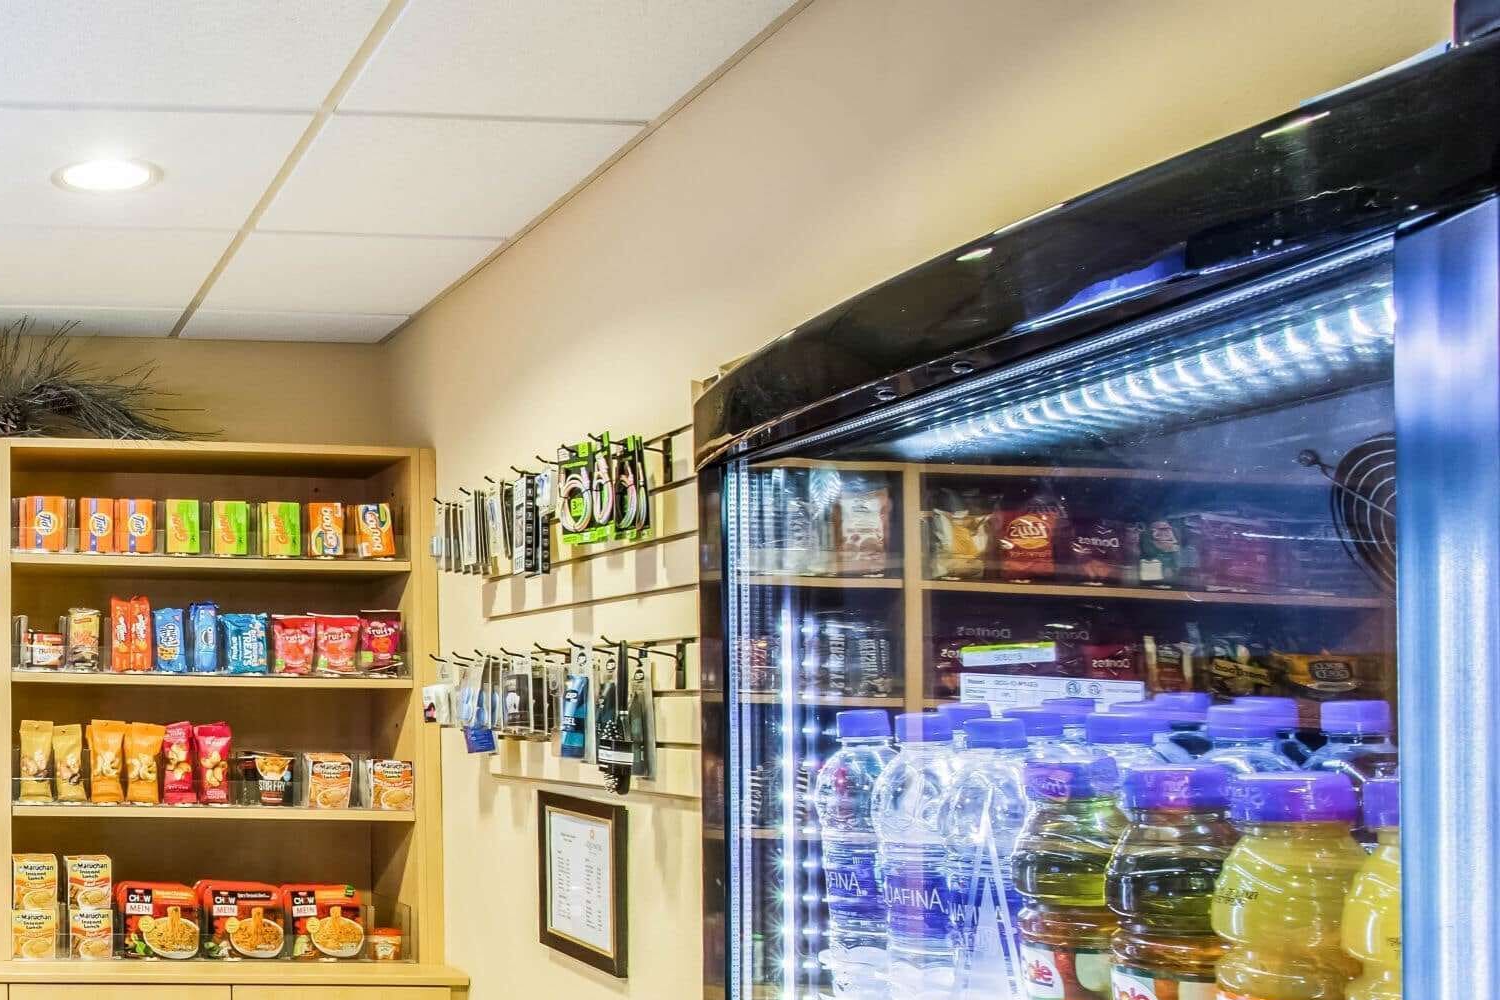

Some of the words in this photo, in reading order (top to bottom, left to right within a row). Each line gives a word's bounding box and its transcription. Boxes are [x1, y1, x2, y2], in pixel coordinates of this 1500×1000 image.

[24, 864, 54, 872] Maruchan
[77, 862, 108, 870] Maruchan
[129, 905, 151, 913] MEIN
[21, 913, 52, 921] Maruchan
